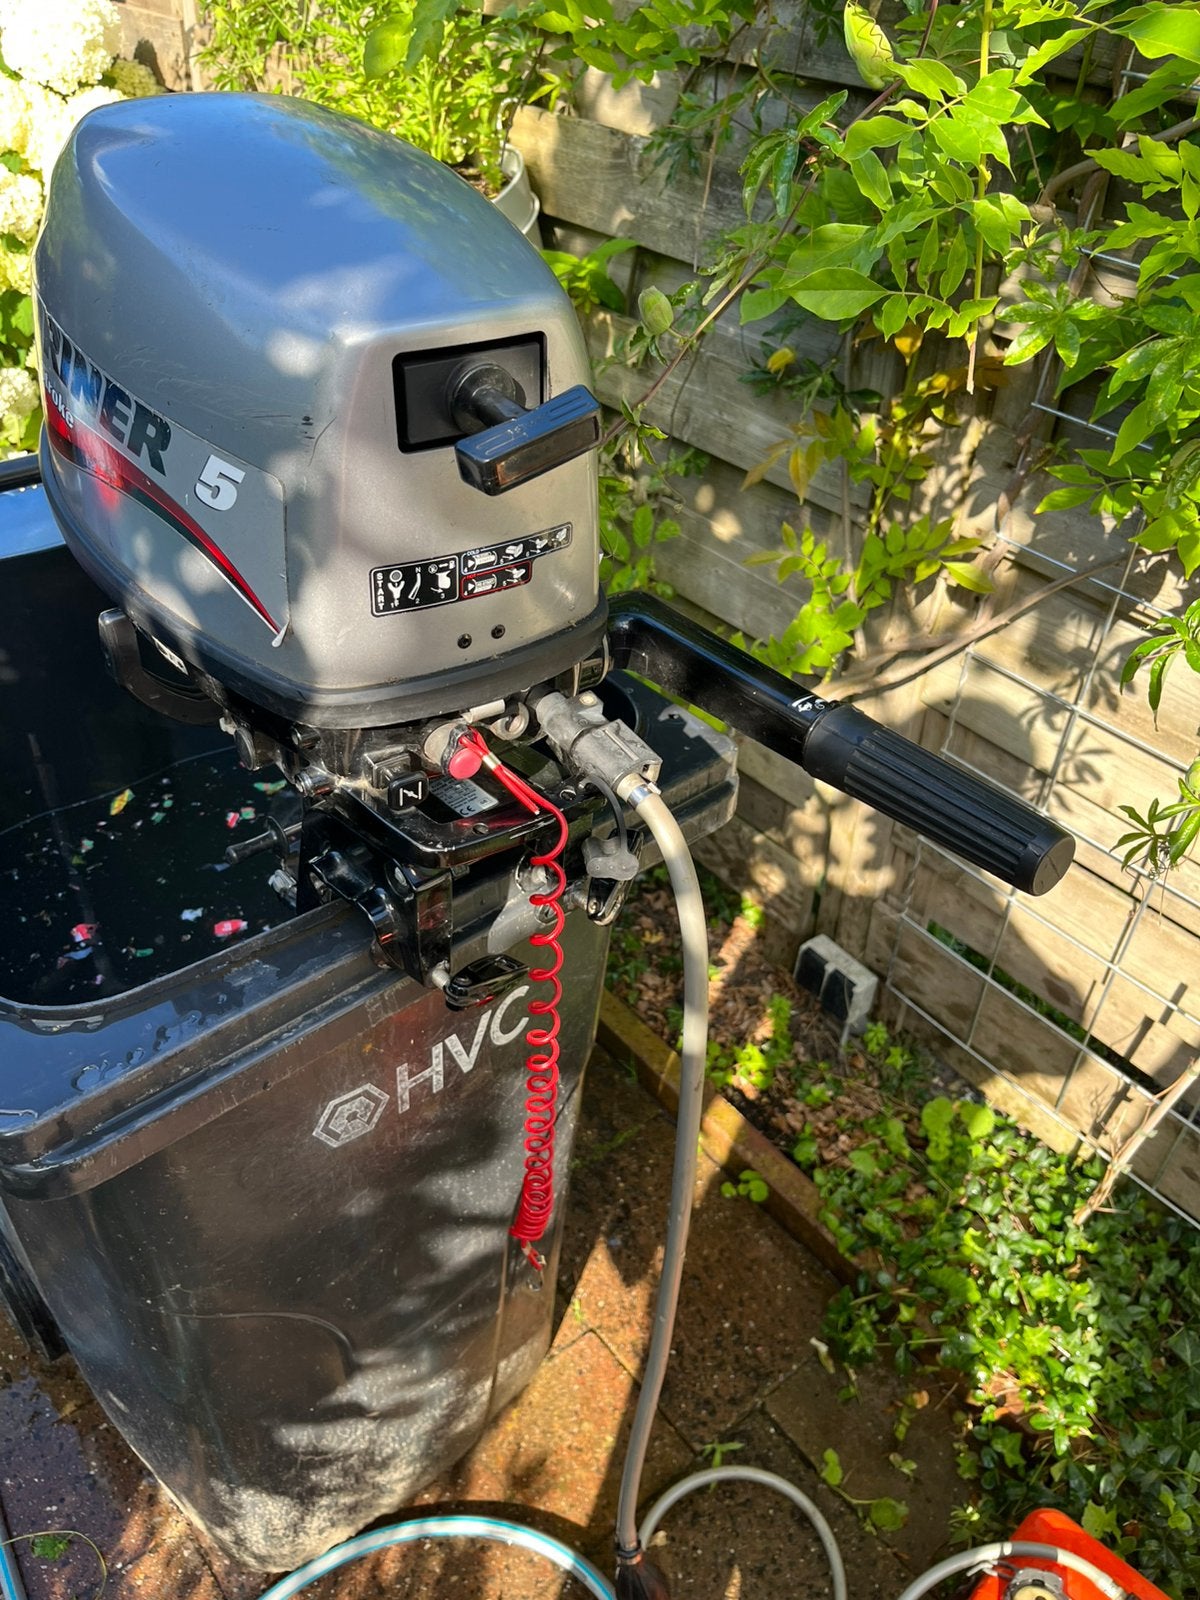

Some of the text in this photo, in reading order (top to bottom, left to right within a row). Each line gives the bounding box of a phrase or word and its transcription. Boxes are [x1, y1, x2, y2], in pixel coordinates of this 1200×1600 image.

[194, 454, 246, 512] 5
[376, 572, 385, 611] START
[460, 805, 476, 816] CE
[396, 985, 530, 1114] HVC
